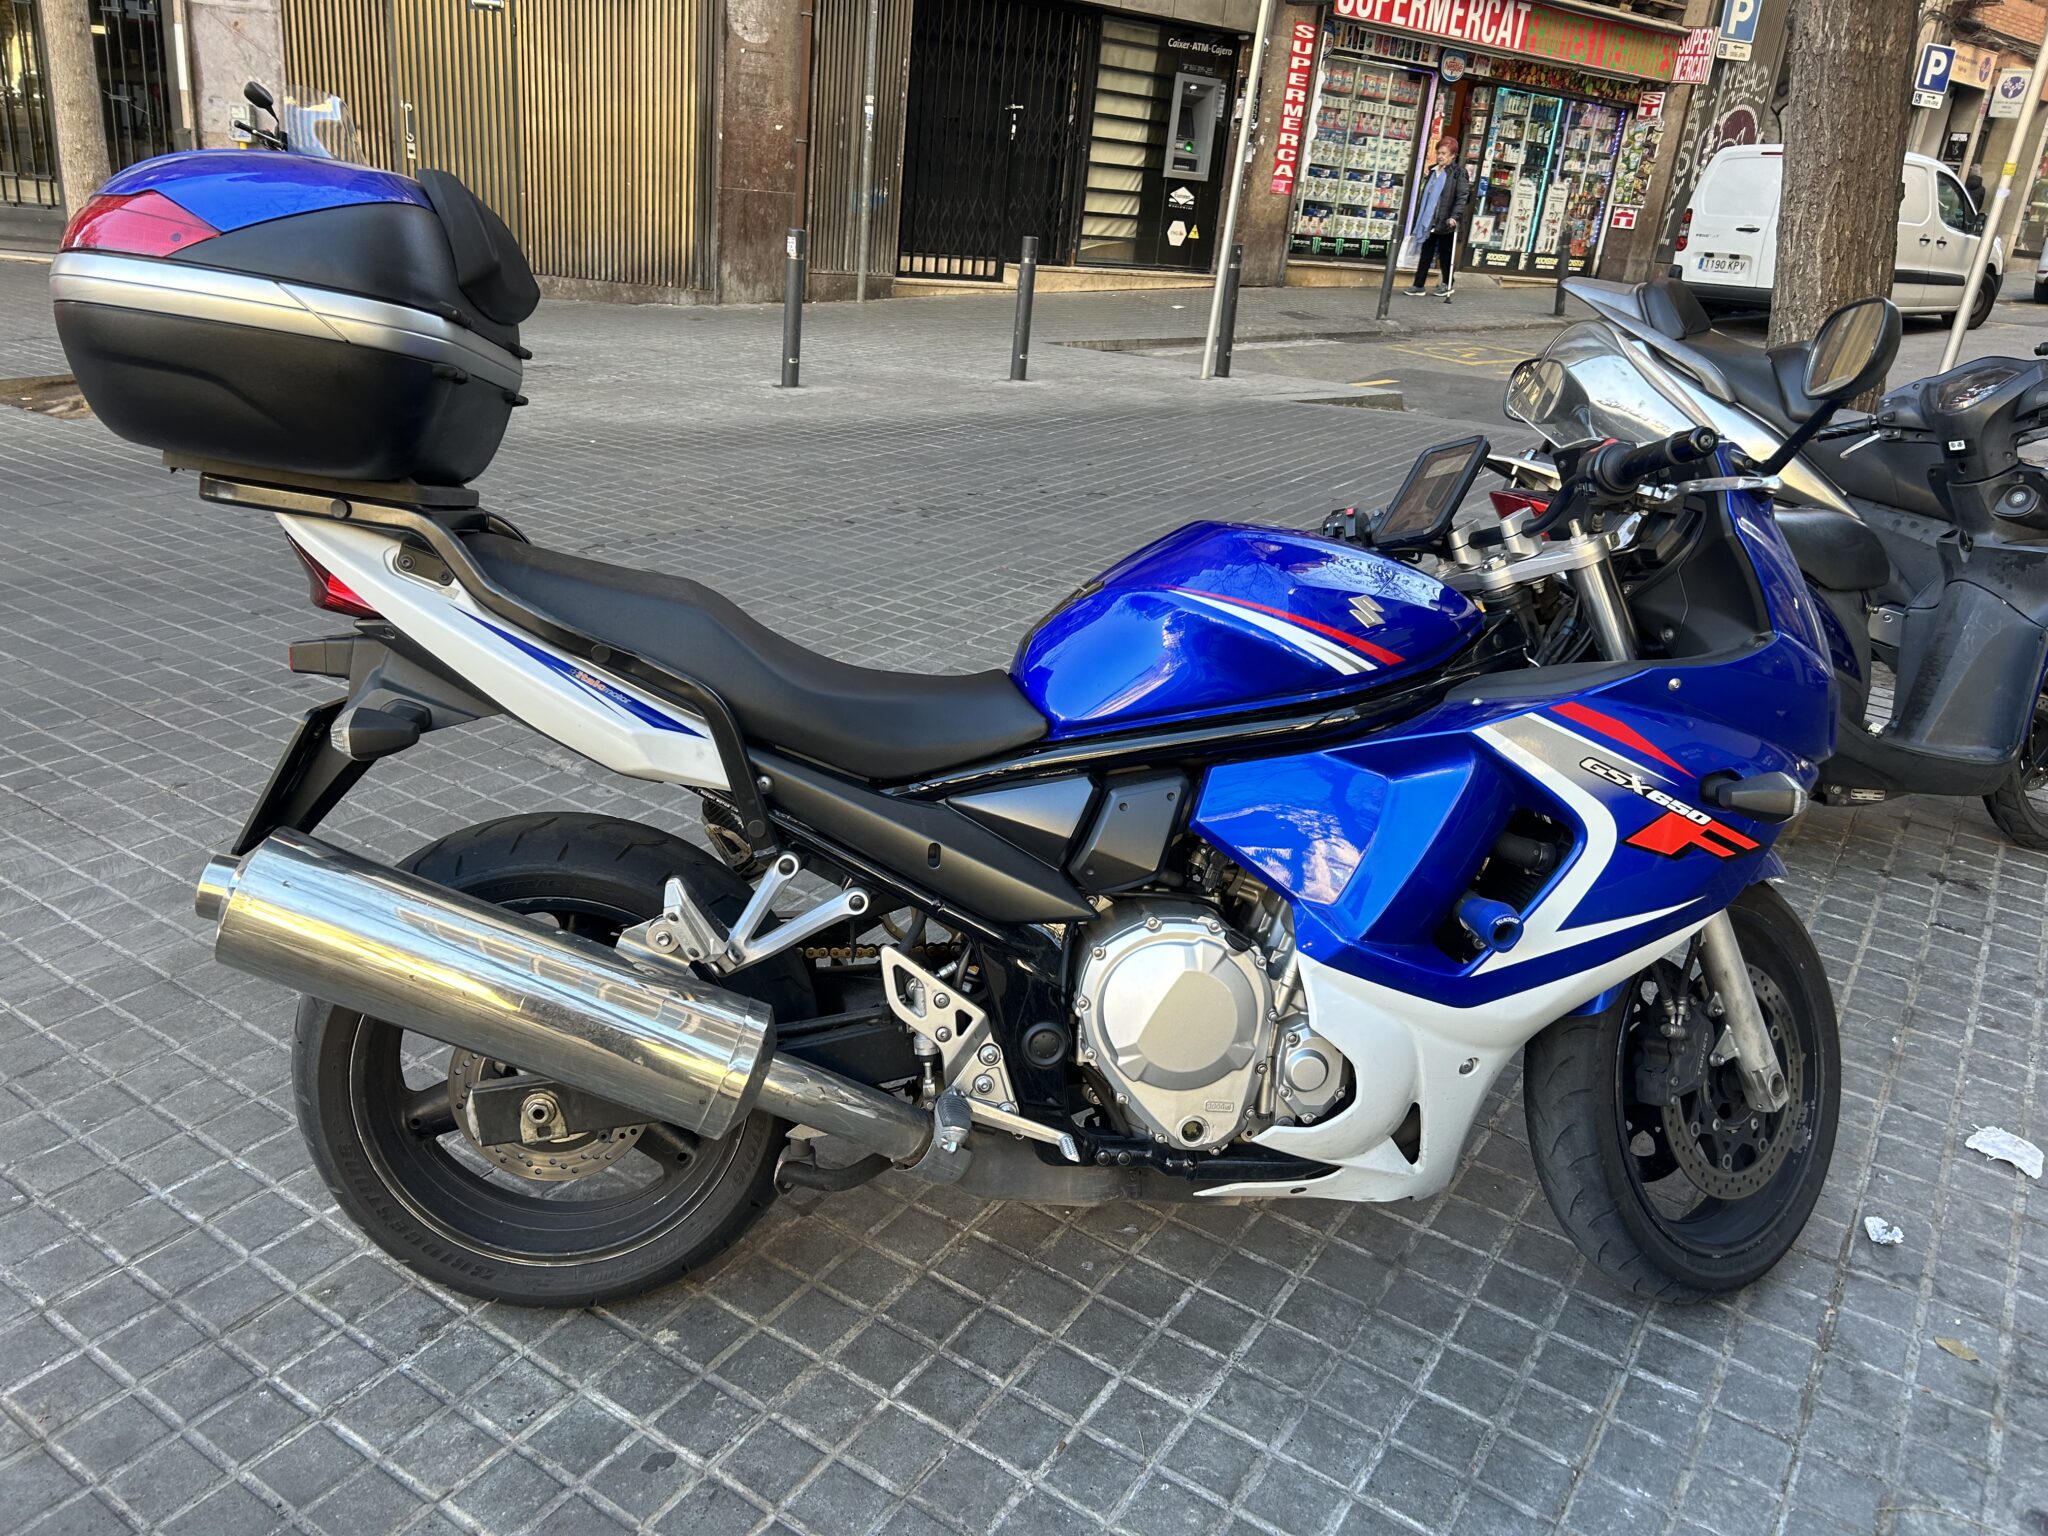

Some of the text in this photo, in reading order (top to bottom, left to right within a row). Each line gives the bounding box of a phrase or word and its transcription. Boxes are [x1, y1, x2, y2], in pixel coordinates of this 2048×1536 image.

[1525, 7, 1593, 63] FRUITES
[1678, 28, 1714, 55] SUPER
[1672, 55, 1709, 81] MERCAT
[1923, 50, 1948, 86] P
[1272, 24, 1316, 192] SUPERMERCAT
[1705, 259, 1746, 271] 1190 KPV
[1579, 756, 1713, 826] GSX650
